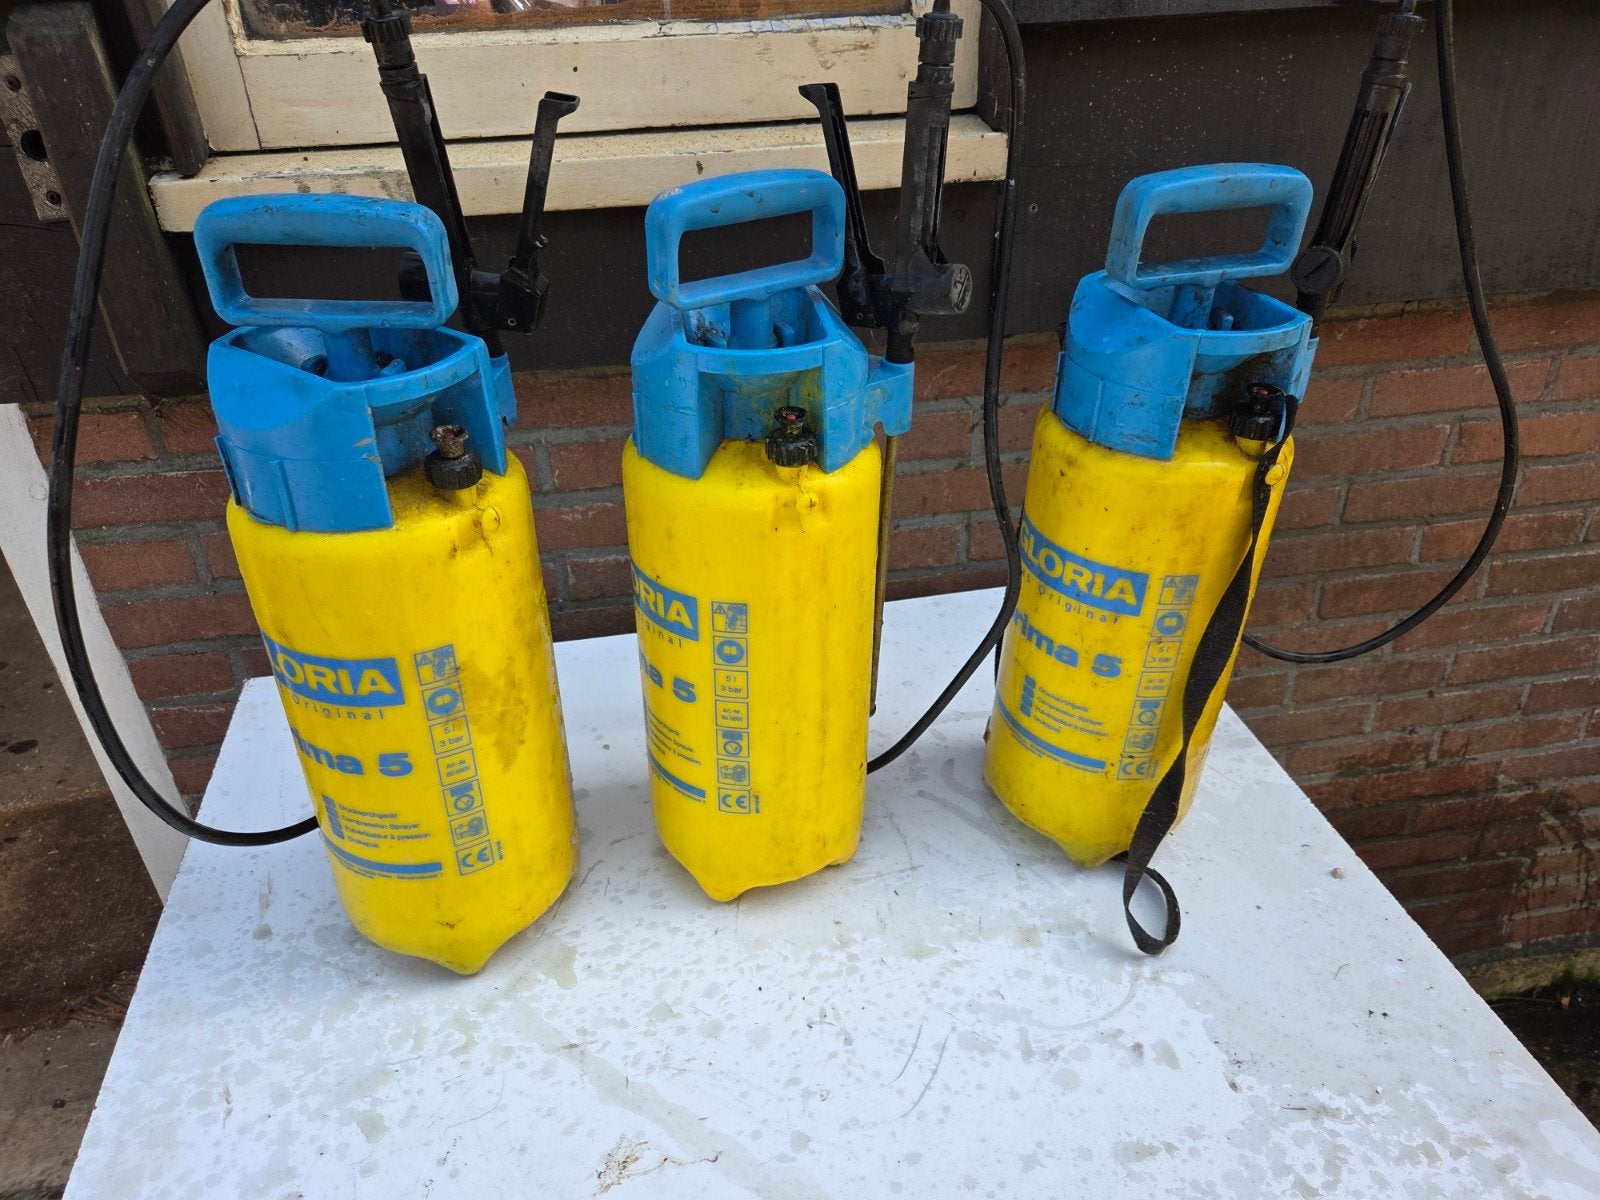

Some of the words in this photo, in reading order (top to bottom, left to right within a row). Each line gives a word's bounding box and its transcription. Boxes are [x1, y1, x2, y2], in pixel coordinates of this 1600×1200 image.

[1021, 521, 1138, 606] GLORIA
[631, 564, 694, 631] ORIA
[1038, 584, 1120, 625] Original
[1013, 607, 1079, 669] rima
[1091, 653, 1122, 678] 5
[672, 676, 697, 703] 5
[726, 675, 732, 683] 5
[728, 686, 743, 694] bar
[291, 692, 384, 720] Original
[439, 739, 447, 748] 3
[448, 735, 464, 745] bar
[443, 726, 451, 735] 5
[378, 752, 413, 778] 5
[721, 794, 747, 810] CE
[461, 846, 490, 868] CE
